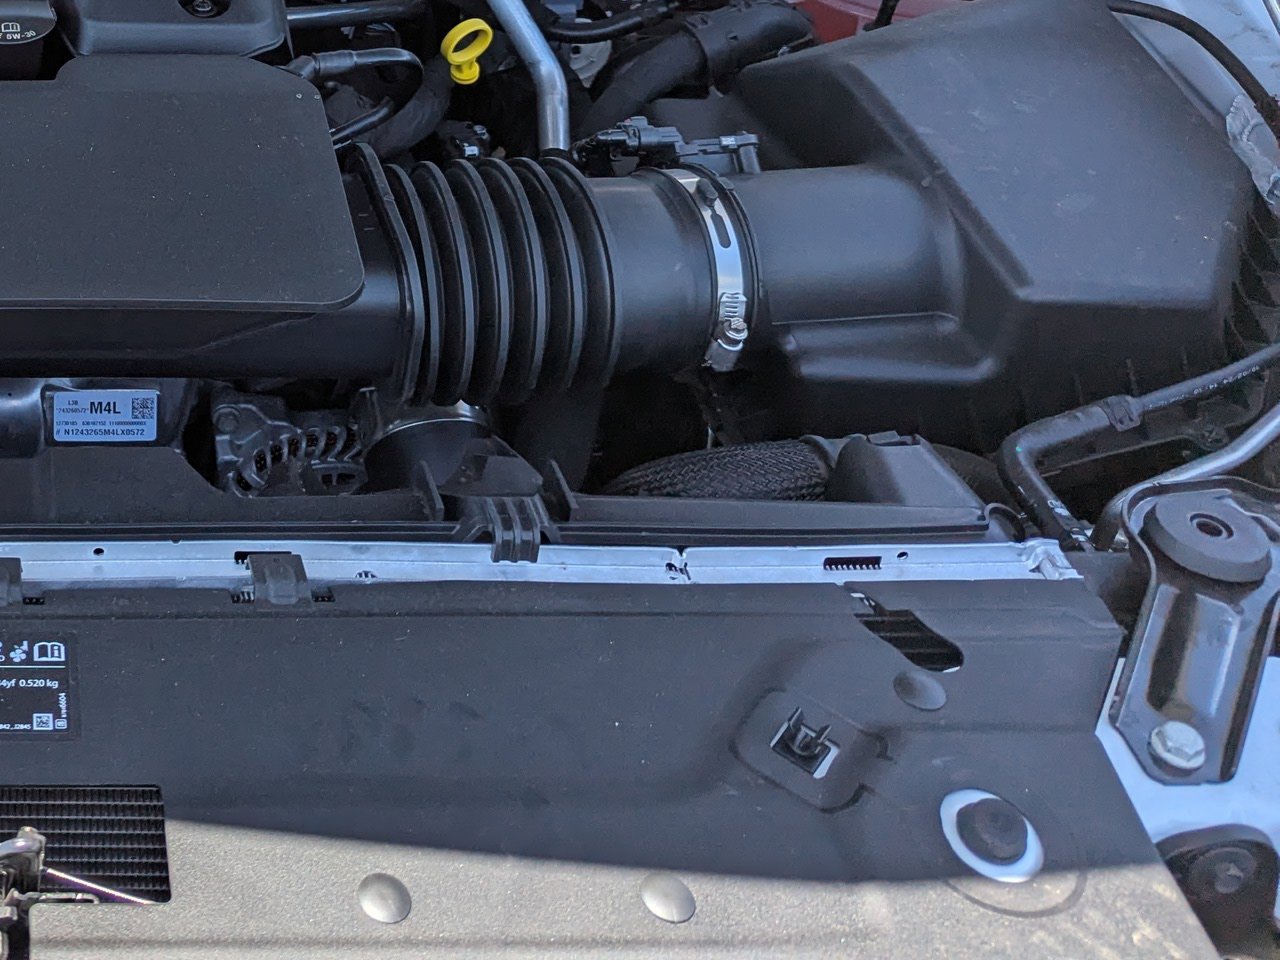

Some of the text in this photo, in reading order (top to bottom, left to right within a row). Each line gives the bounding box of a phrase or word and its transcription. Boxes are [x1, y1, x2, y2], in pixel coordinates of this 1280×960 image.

[6, 30, 36, 40] 5W-30
[90, 402, 121, 414] M4L
[19, 678, 45, 687] 0.520
[46, 678, 58, 688] kg
